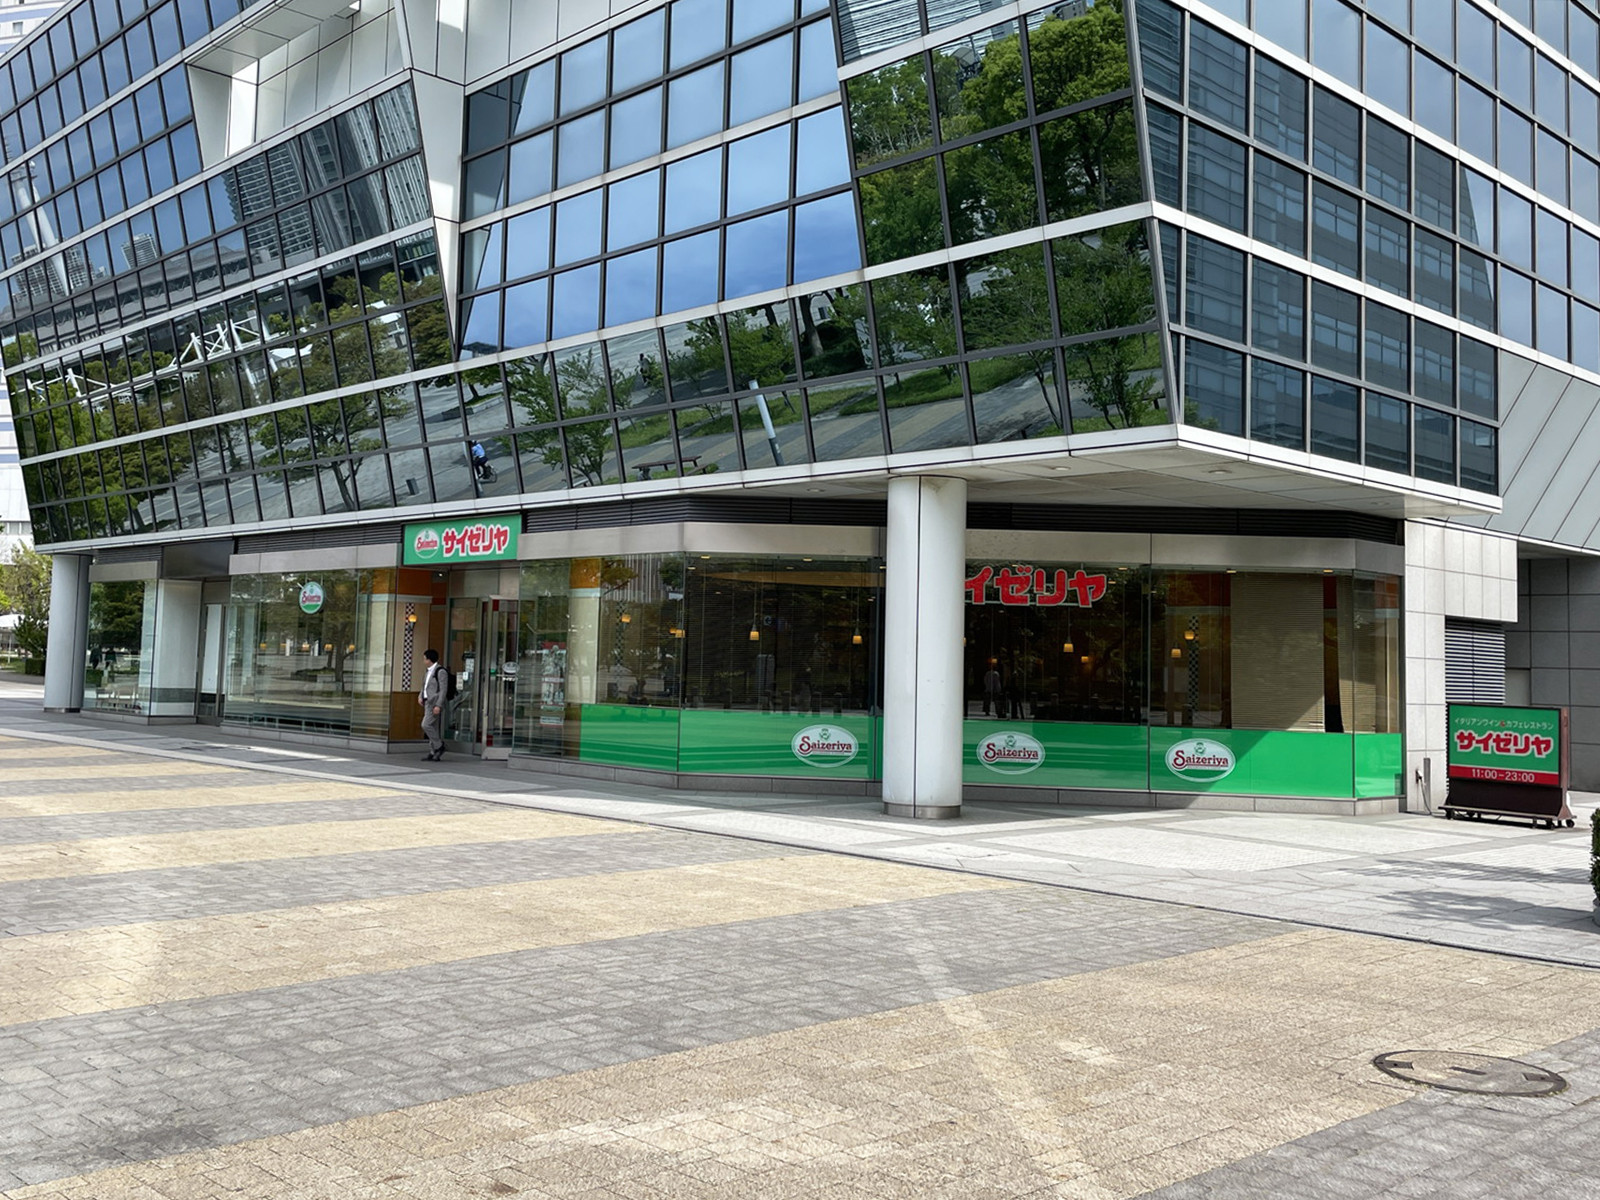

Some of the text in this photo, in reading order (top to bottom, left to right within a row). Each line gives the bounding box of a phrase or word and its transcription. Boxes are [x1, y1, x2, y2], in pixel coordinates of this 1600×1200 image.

[442, 524, 510, 557] サイゼリヤ
[799, 735, 852, 753] Saizeriya
[984, 742, 1039, 760] Saizeriya
[1454, 729, 1554, 758] サイゼリヤ
[1173, 749, 1229, 767] Saizeriya
[1471, 768, 1535, 783] 11:00-23:00
